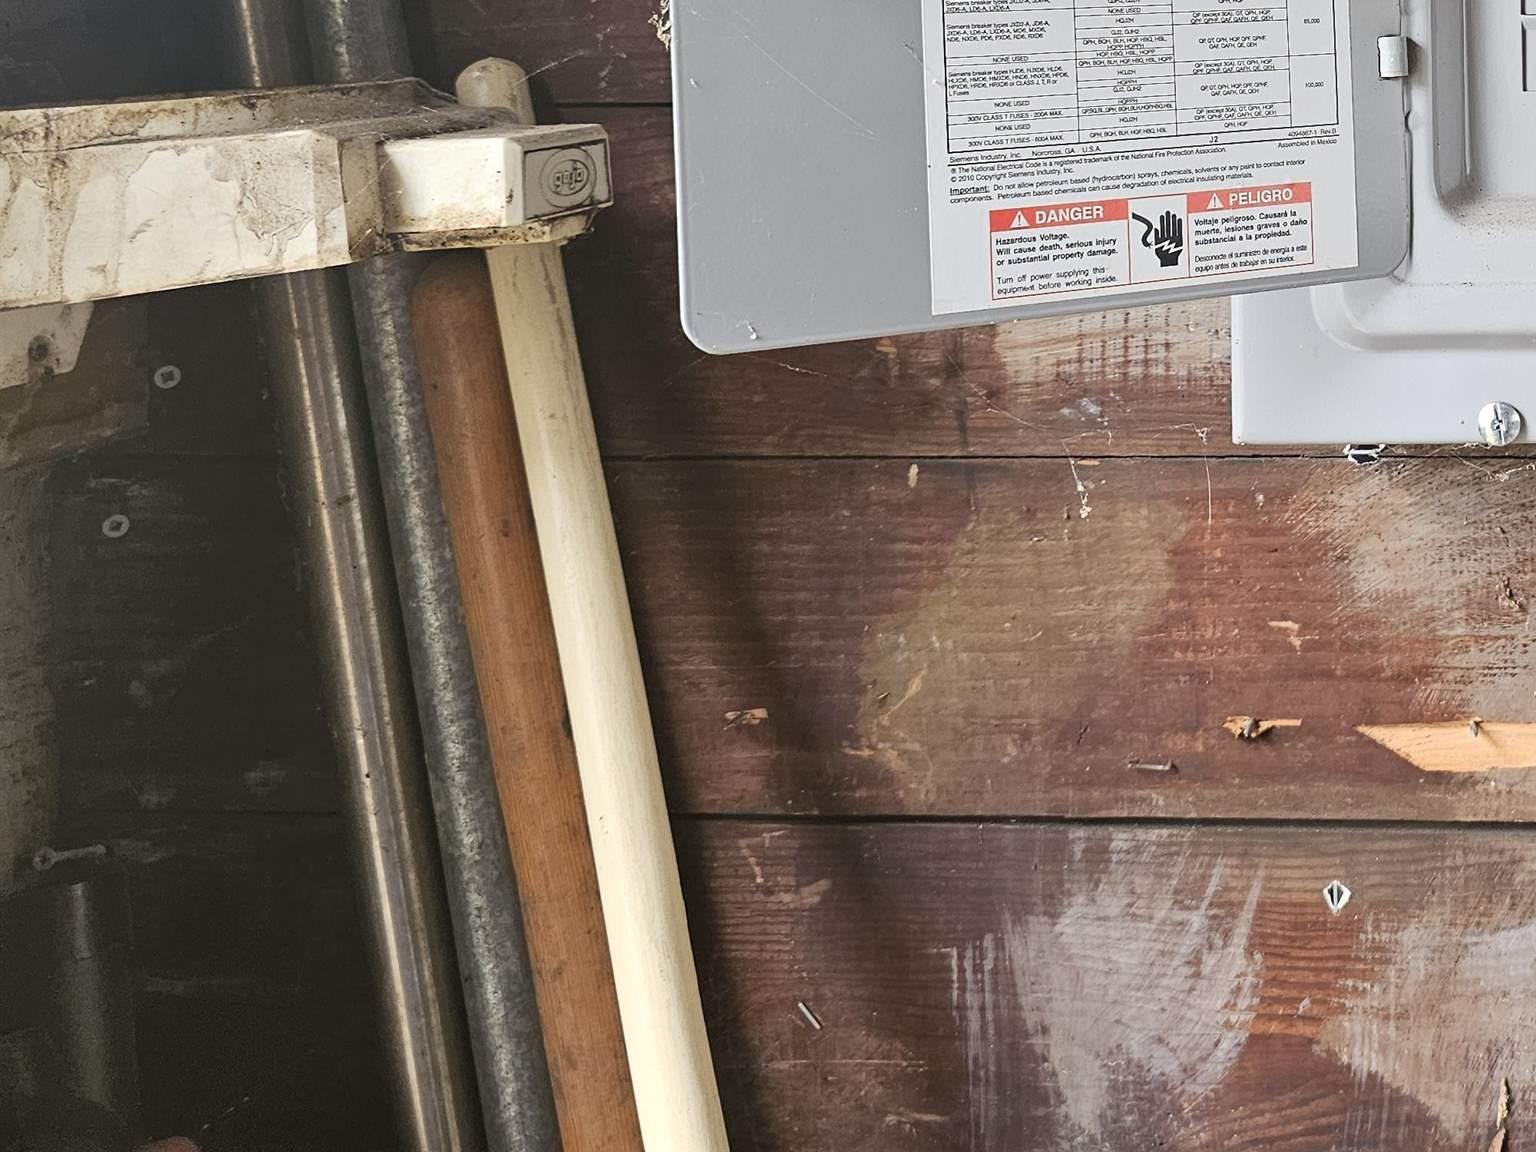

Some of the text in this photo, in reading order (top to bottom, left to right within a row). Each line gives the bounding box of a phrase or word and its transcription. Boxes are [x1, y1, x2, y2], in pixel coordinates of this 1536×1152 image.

[1209, 135, 1218, 143] J2
[1277, 140, 1309, 148] Assembled
[553, 160, 585, 191] gojo
[949, 185, 989, 195] Important:
[1035, 179, 1068, 188] petroleum
[1069, 176, 1089, 184] based
[1160, 168, 1193, 176] chemicals,
[1229, 188, 1292, 205] PELIGRO
[1035, 205, 1103, 223] DANGER
[1193, 217, 1218, 226] Voltaje
[1224, 224, 1253, 232] lesiones
[1256, 222, 1280, 231] graves
[995, 233, 1069, 245] Hazardous Voltage.
[996, 238, 1116, 255] Will cause death, serious injury
[1194, 234, 1236, 245] substancial
[1007, 253, 1049, 264] substantial
[1052, 251, 1084, 261] property
[1086, 248, 1118, 256] damage.
[996, 266, 1105, 284] Turn off power supplying this
[997, 275, 1117, 295] equipment before working inside.
